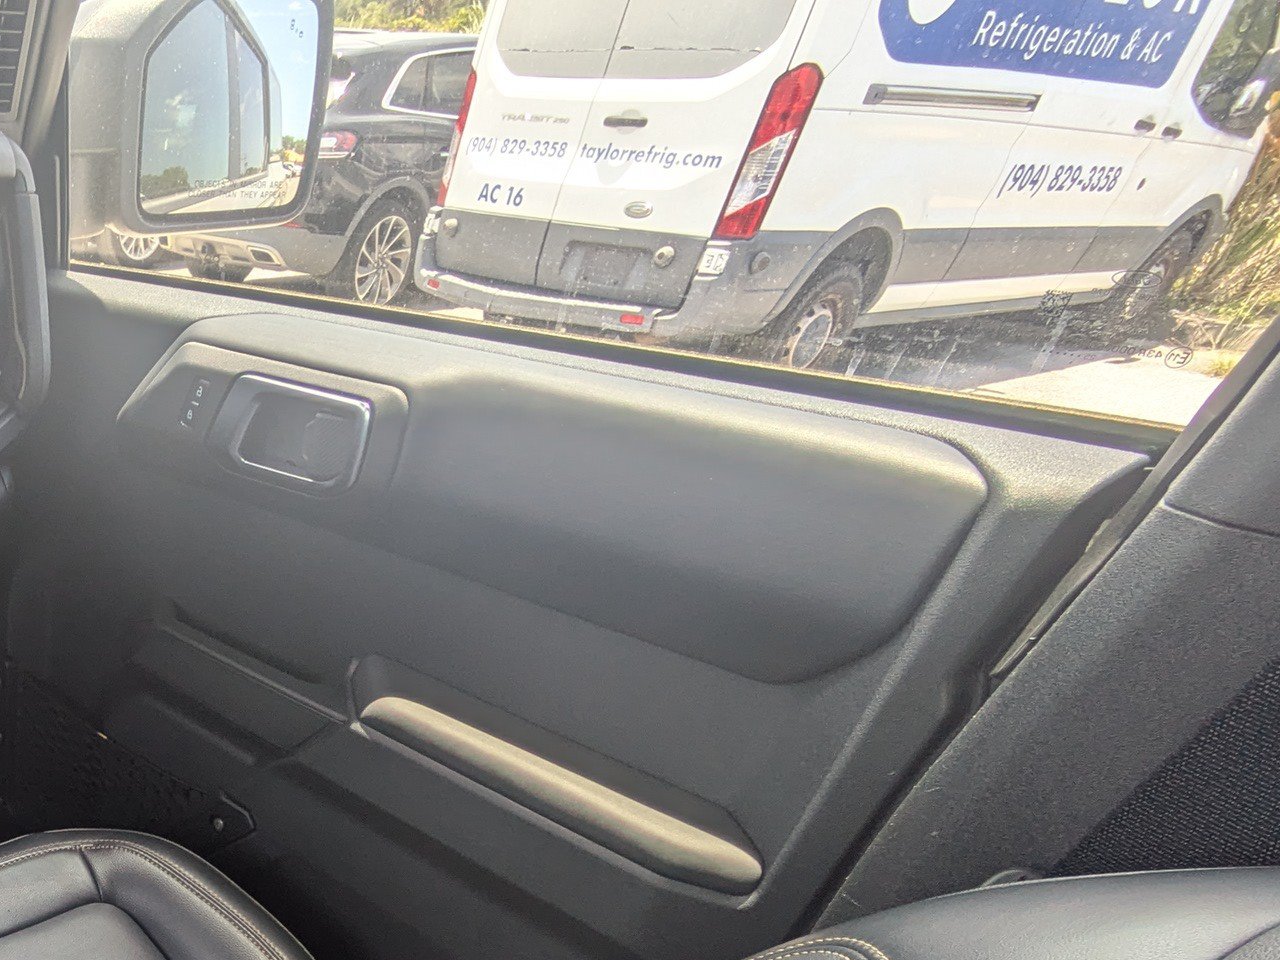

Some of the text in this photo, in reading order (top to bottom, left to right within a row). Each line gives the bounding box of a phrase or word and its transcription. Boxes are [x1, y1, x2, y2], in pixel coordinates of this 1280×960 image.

[972, 10, 1173, 62] Refrigeration & AC
[466, 137, 568, 157] (904) 829-3358
[579, 143, 722, 168] taylorrefrig.com
[996, 164, 1122, 198] (904) 829-3358
[477, 183, 524, 206] AC 16
